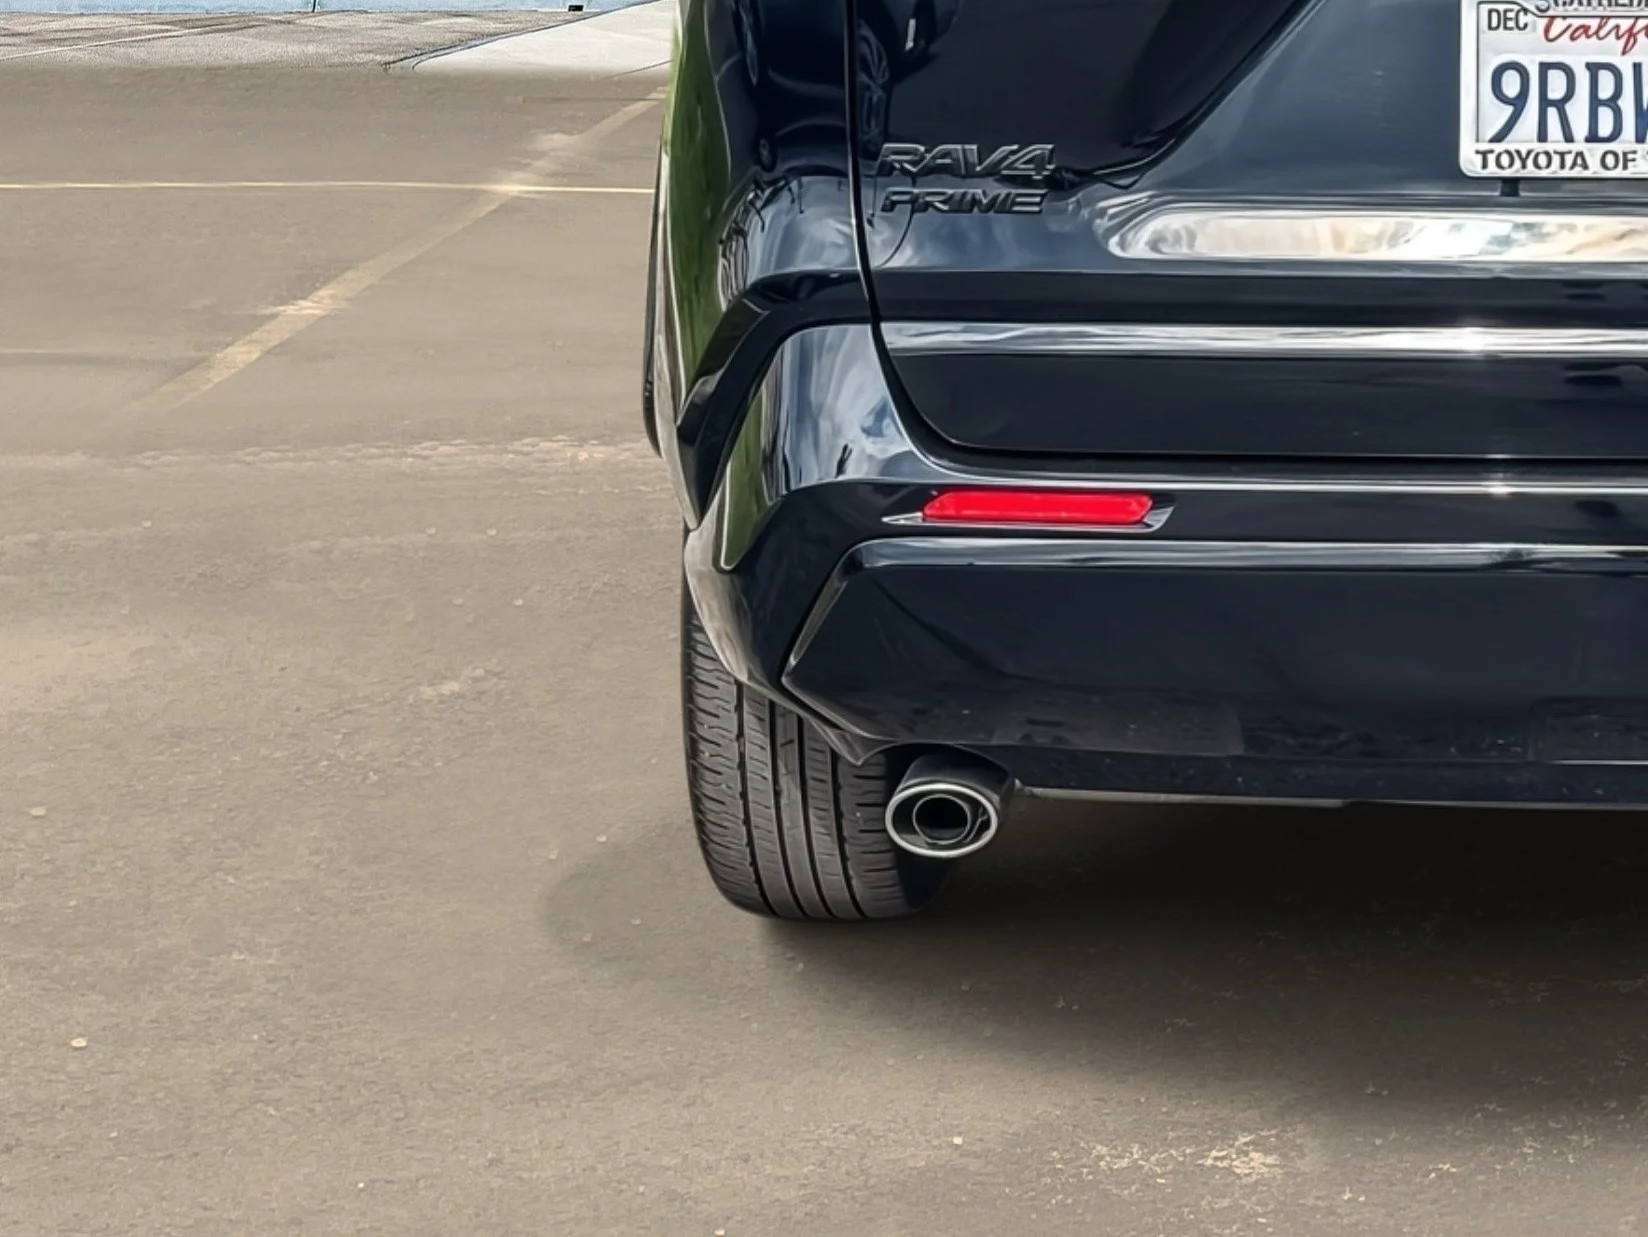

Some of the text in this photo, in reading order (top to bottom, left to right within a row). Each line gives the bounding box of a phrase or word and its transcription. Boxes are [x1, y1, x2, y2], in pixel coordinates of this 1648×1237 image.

[1486, 8, 1529, 32] DEC
[875, 143, 1056, 179] RAV4
[1475, 149, 1589, 172] TOYOTA
[1600, 150, 1637, 172] OF
[880, 187, 1048, 214] PRIME
